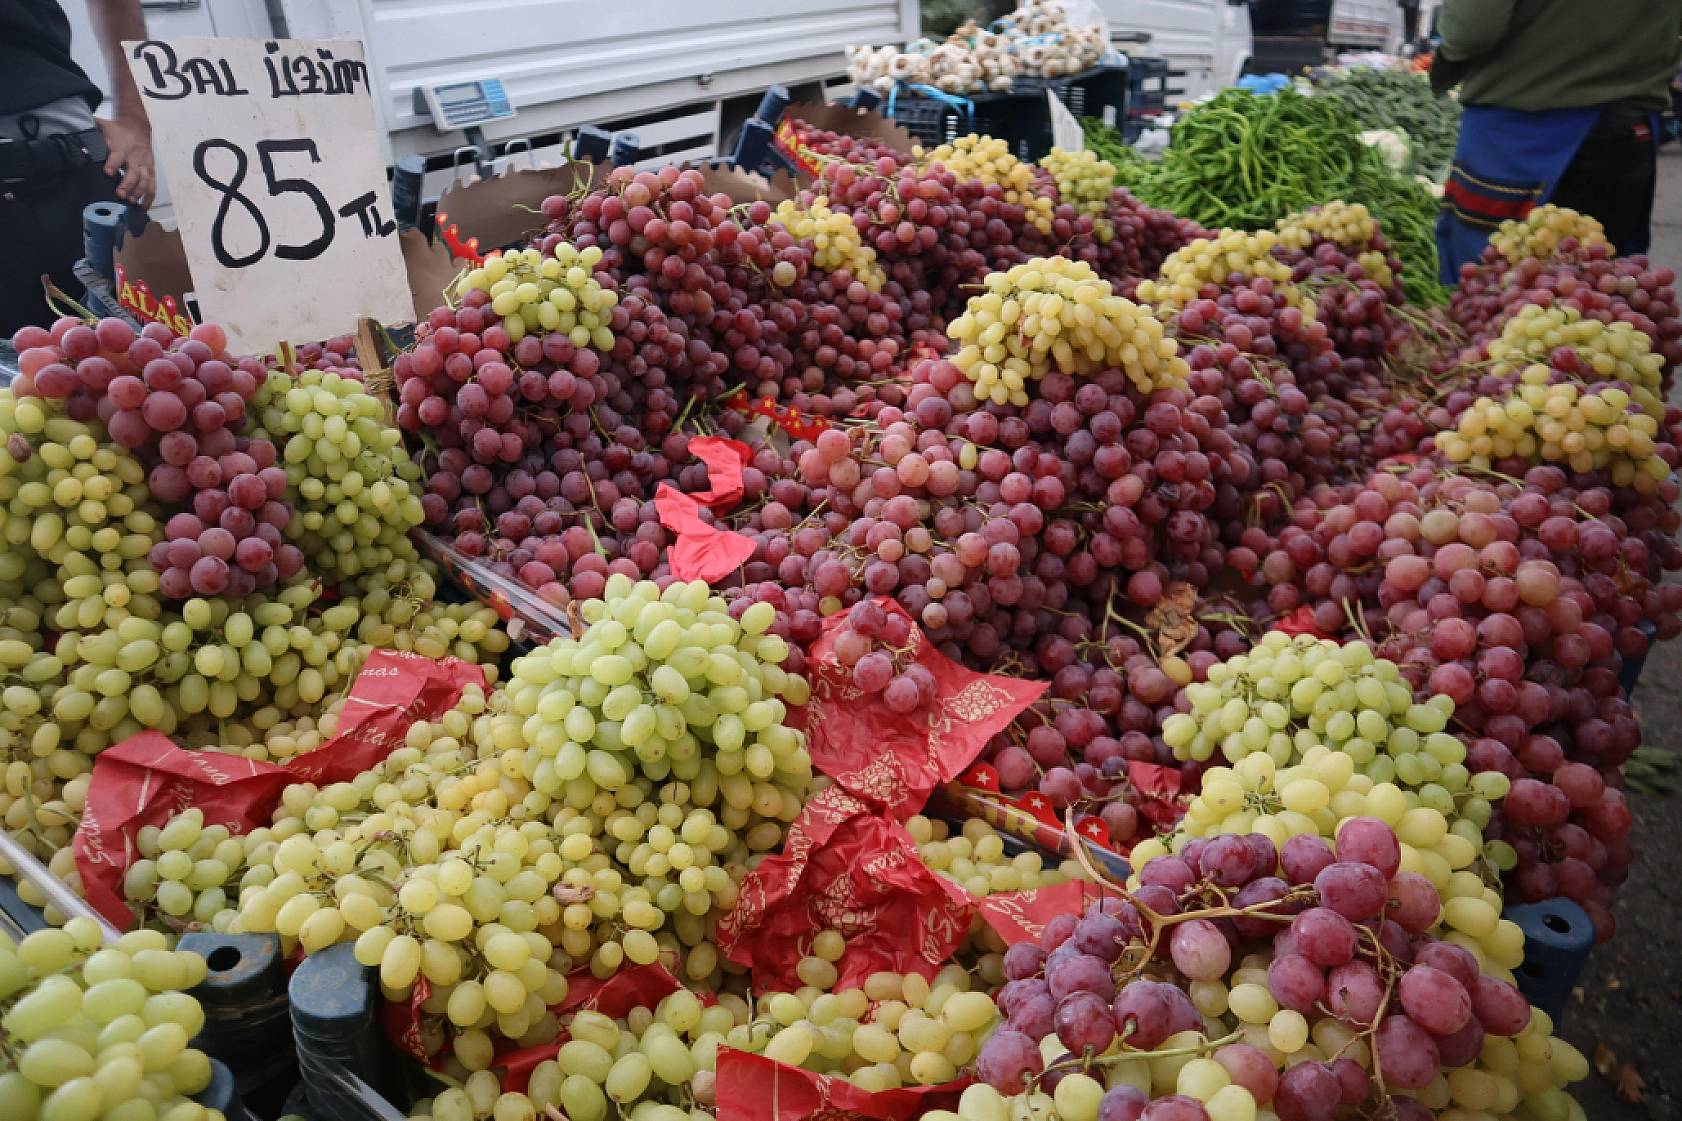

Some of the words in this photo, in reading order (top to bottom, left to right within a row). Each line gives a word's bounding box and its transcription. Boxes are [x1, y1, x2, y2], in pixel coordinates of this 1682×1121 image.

[134, 40, 249, 99] BAL
[193, 138, 335, 268] 85
[338, 190, 396, 239] TL
